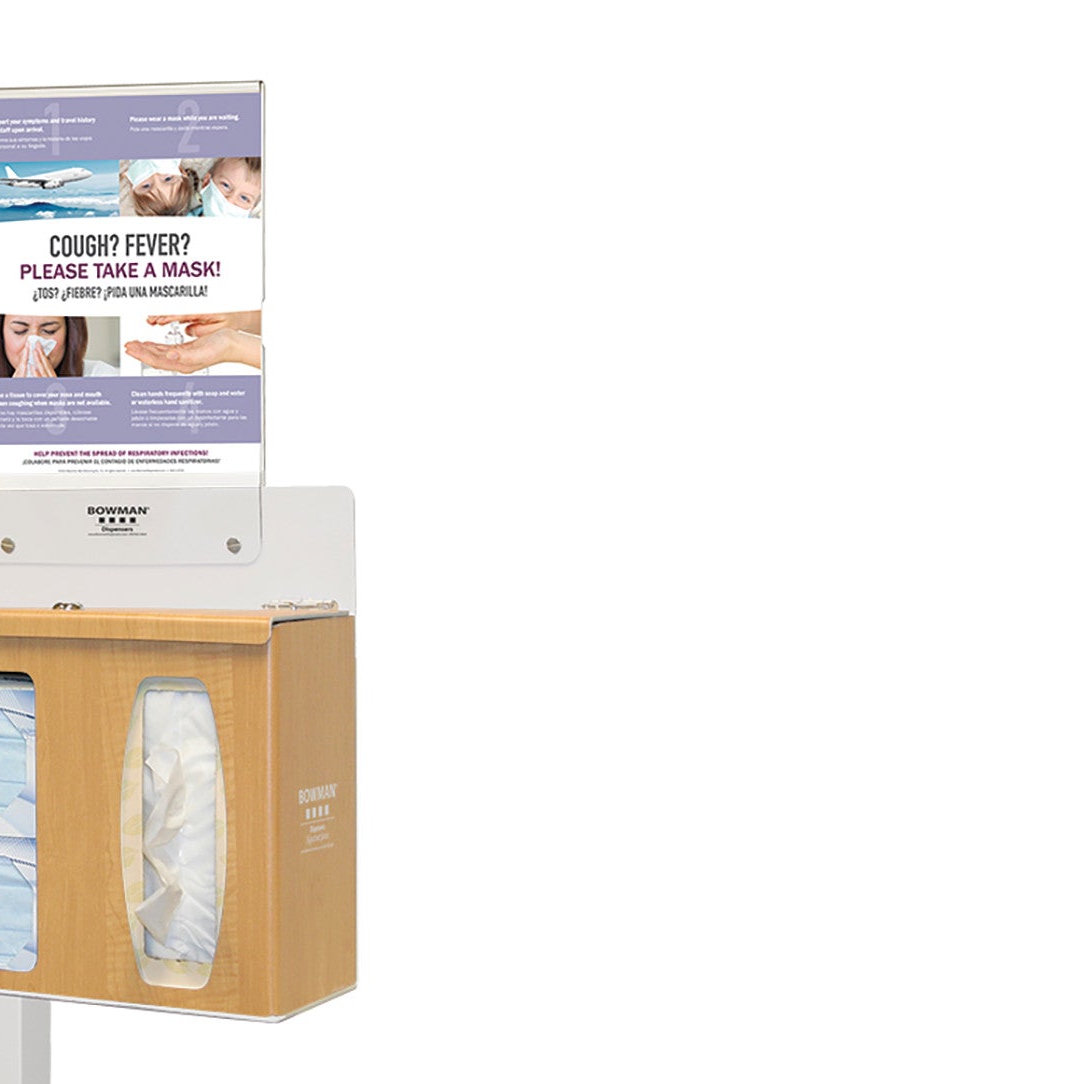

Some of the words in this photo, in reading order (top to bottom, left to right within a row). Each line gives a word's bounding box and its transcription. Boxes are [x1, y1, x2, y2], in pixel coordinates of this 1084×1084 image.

[178, 99, 200, 153] 2
[49, 233, 119, 258] COUGH?
[125, 232, 191, 256] FEVER?
[20, 263, 88, 280] PLEASE
[93, 262, 138, 279] TAKE
[144, 262, 156, 278] A
[162, 261, 221, 278] MASK!
[32, 287, 59, 302] ¿TOS?
[61, 286, 102, 302] ¿FIEBRE?
[103, 286, 127, 301] ¡PIDA
[129, 286, 147, 298] UNA
[149, 285, 208, 298] MASCARILLA!
[87, 506, 147, 515] BOWMAN
